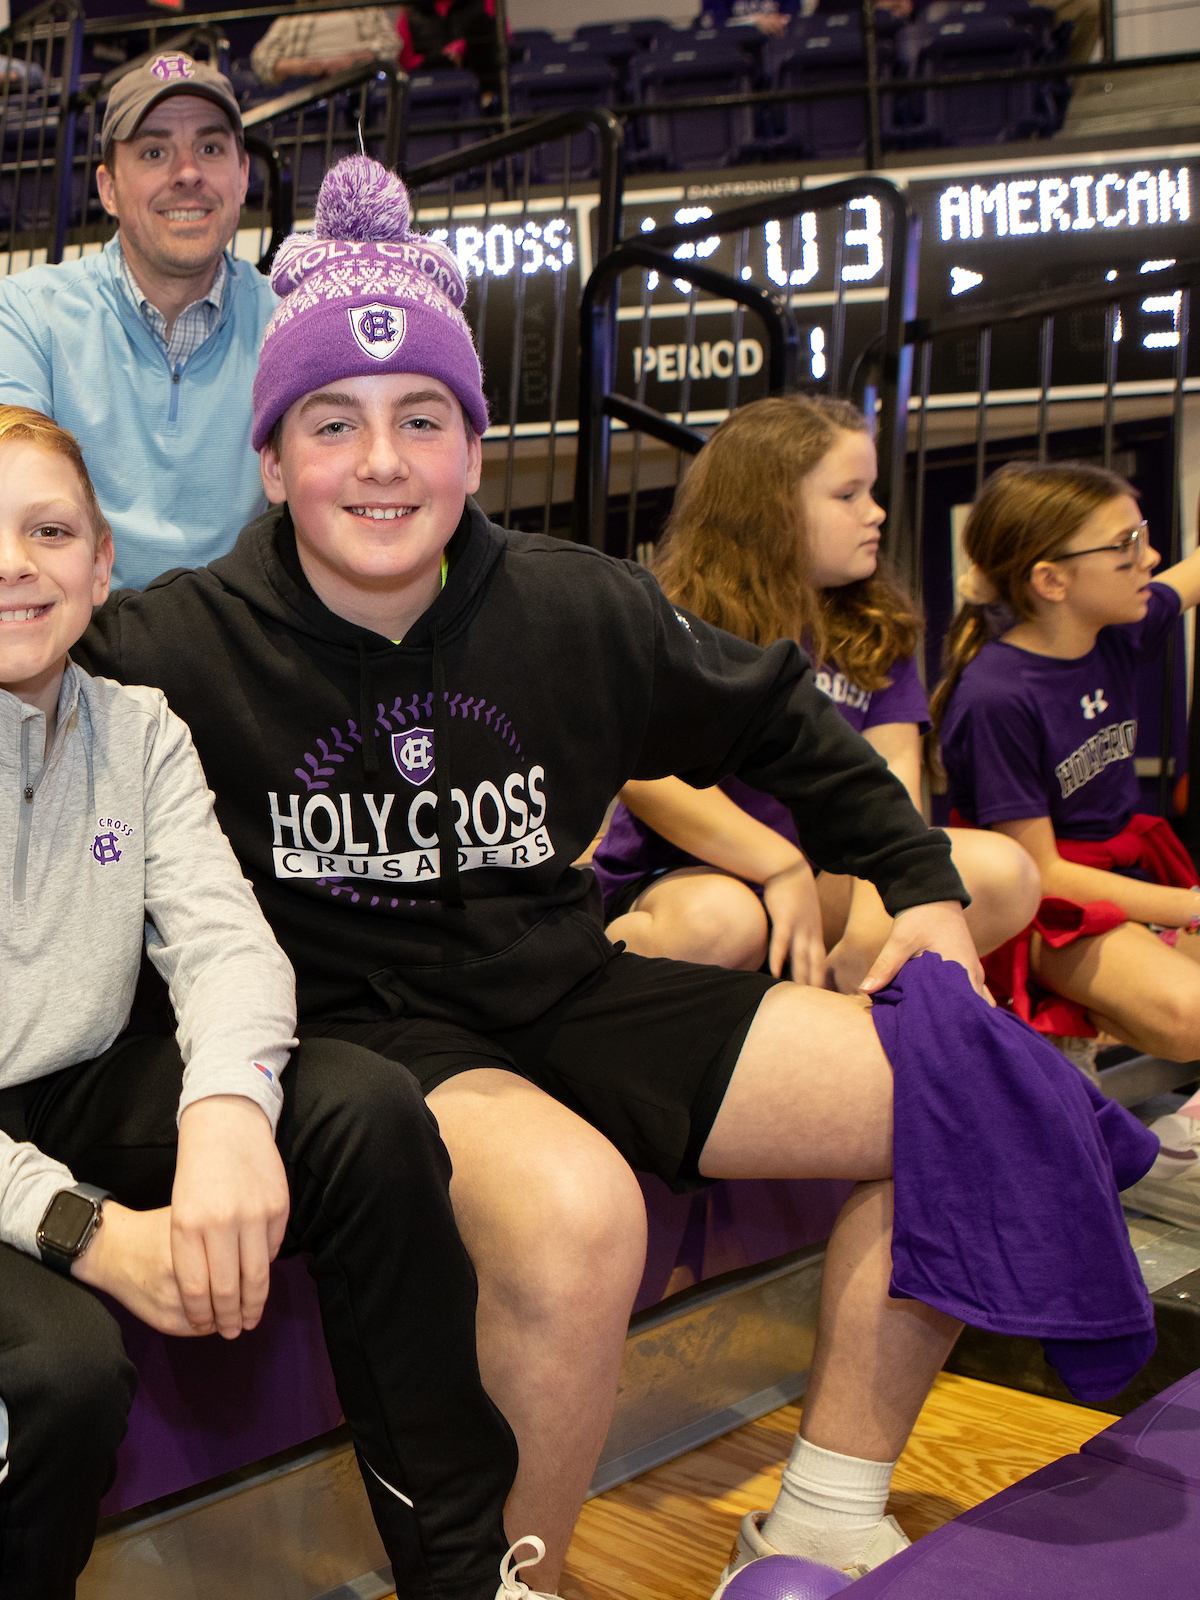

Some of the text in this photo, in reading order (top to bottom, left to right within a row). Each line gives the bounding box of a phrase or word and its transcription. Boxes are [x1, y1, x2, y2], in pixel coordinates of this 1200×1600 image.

[940, 167, 1191, 241] AMERICAN
[286, 242, 368, 286] HOLY
[430, 218, 574, 278] ROSS
[633, 338, 764, 383] PERIOD
[809, 326, 826, 379] 1
[98, 818, 134, 837] CROSS
[267, 764, 547, 855] HOLY CROSS
